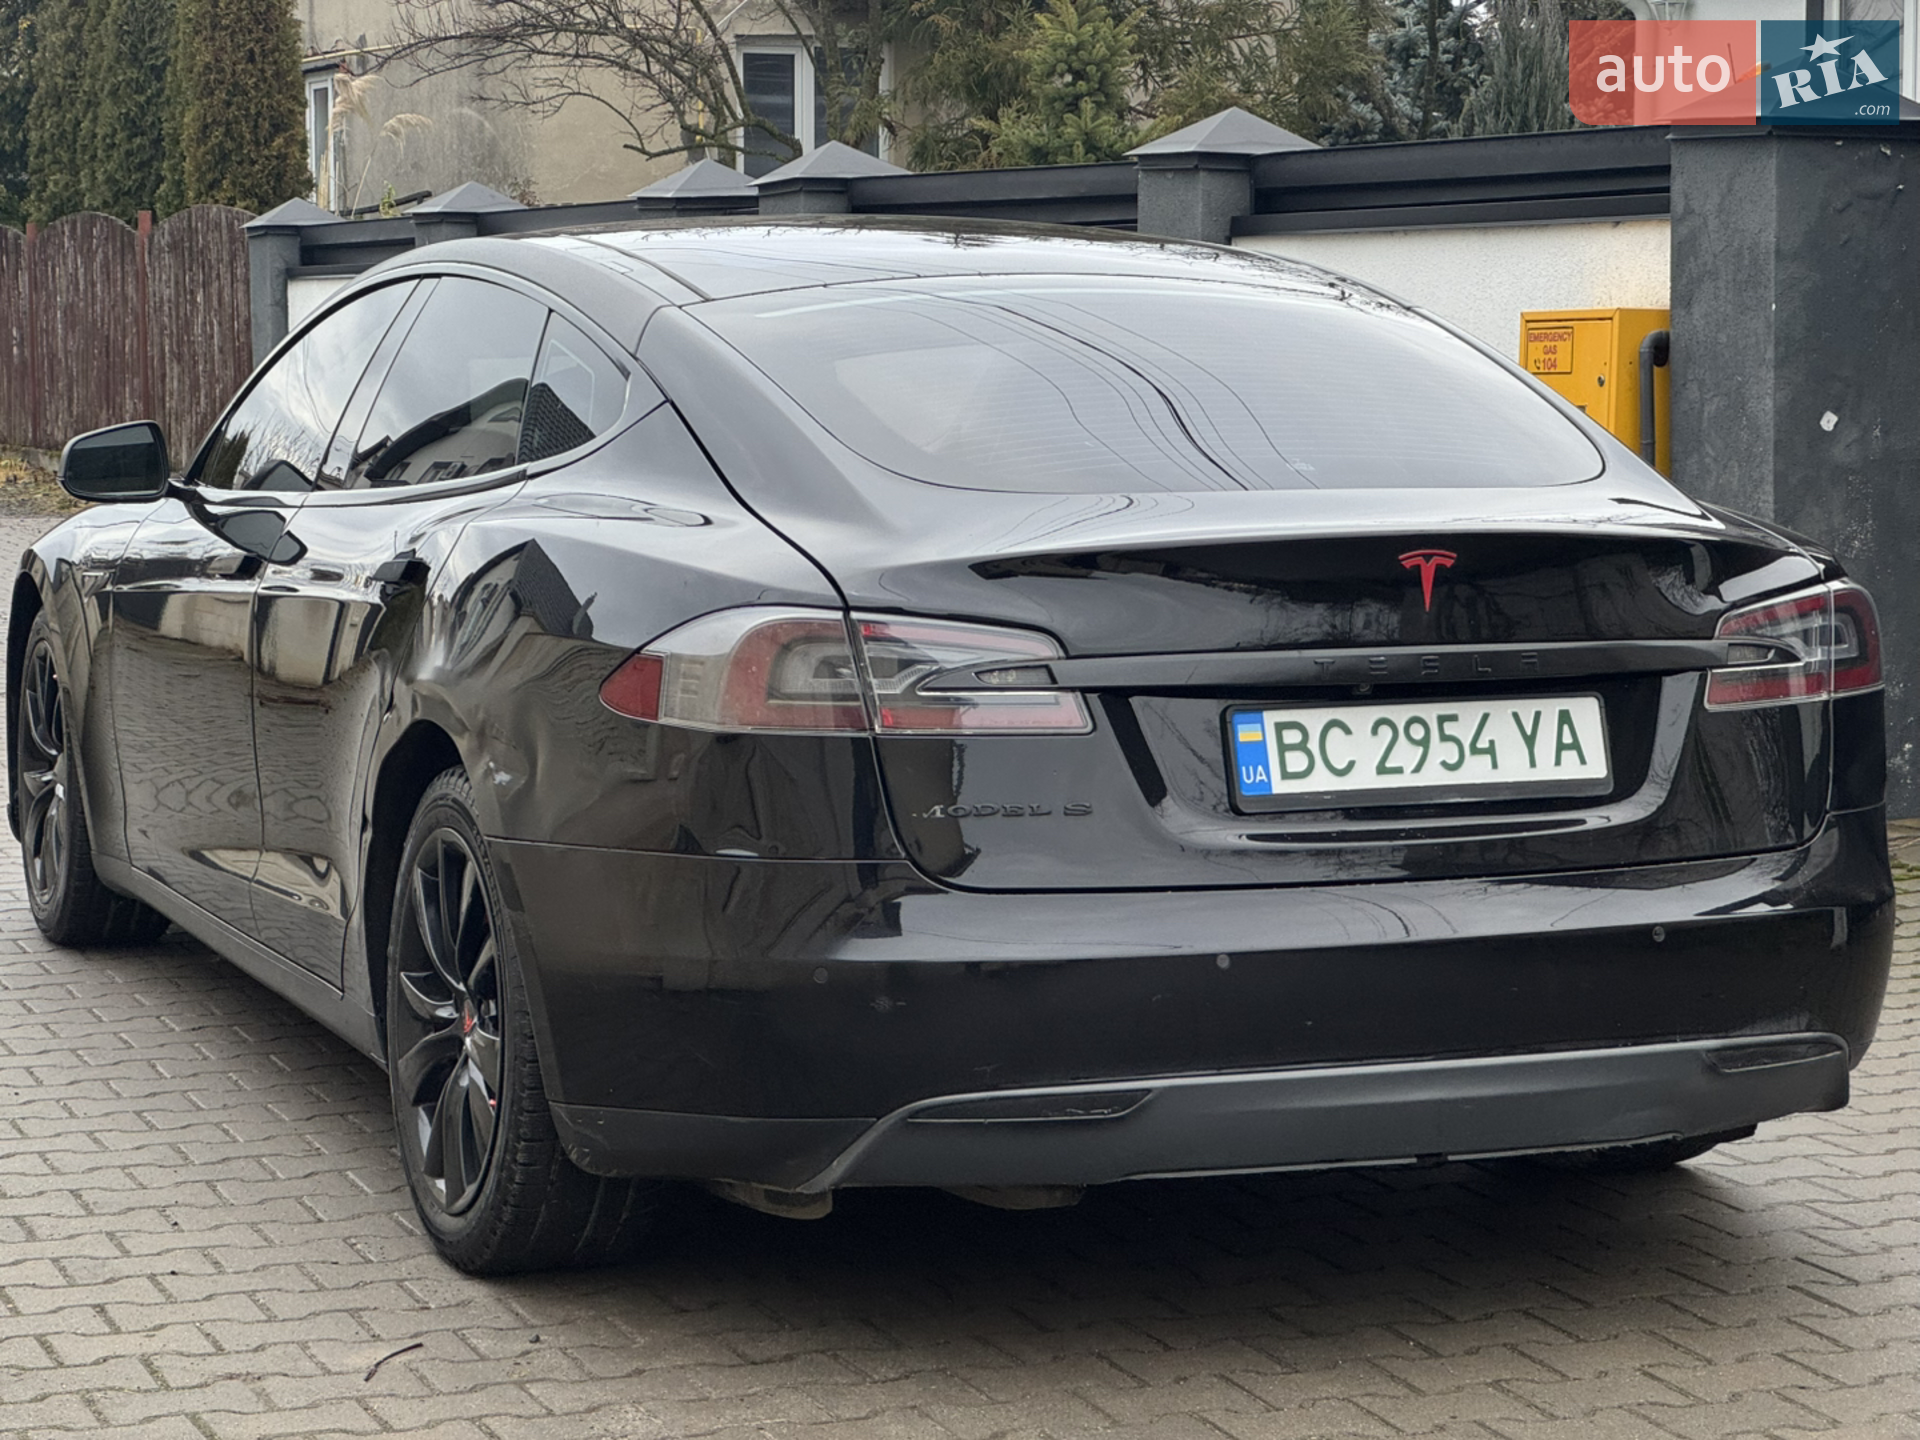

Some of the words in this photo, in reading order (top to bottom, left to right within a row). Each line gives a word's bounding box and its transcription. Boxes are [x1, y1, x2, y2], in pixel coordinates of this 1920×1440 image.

[1528, 332, 1572, 342] EMERGENCY
[1543, 344, 1558, 355] GAS
[1542, 357, 1558, 370] 104
[1313, 652, 1540, 676] TESLA
[1273, 718, 1357, 781] BC
[1370, 712, 1499, 776] 2954
[1511, 709, 1588, 769] YA
[1242, 764, 1268, 785] UA
[1062, 802, 1093, 817] S
